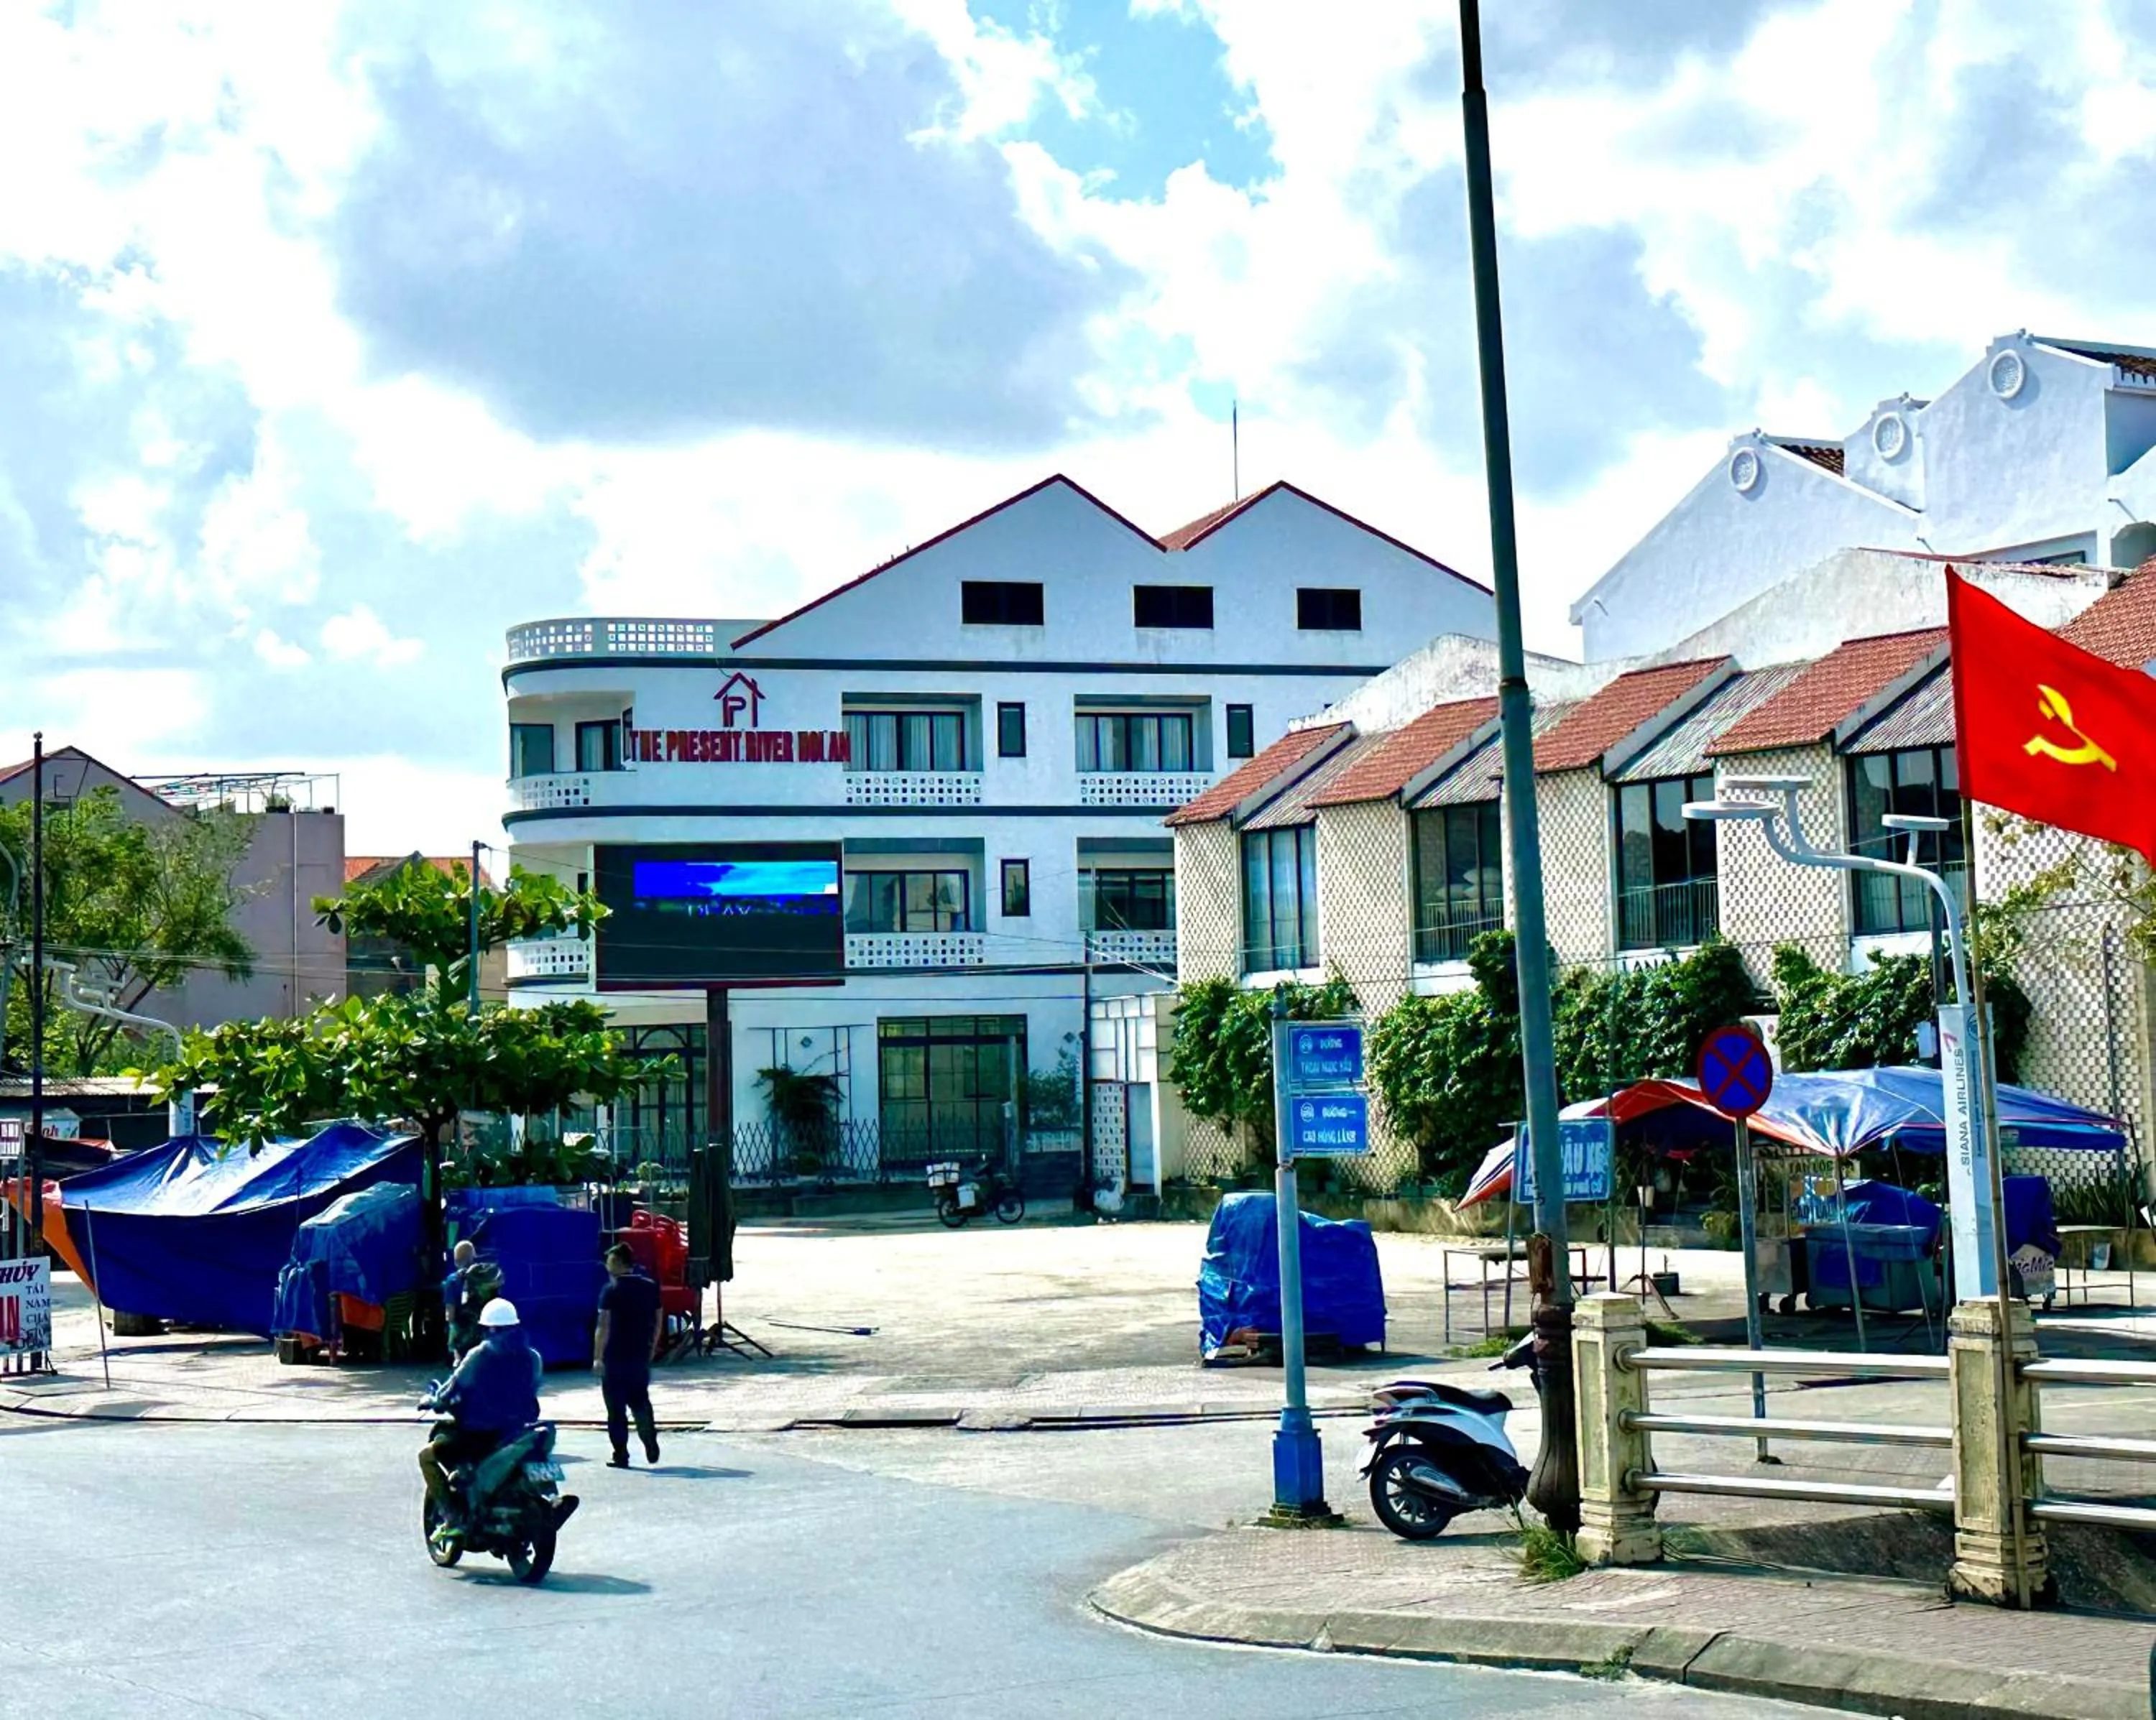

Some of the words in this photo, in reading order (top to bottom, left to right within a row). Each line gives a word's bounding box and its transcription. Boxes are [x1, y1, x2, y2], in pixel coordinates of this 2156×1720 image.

[630, 730, 665, 762] THE
[666, 730, 742, 762] PRESENT
[745, 731, 793, 762] RIVER
[828, 731, 851, 762] AN
[1953, 1048, 1968, 1116] AIRLINES
[1959, 1120, 1971, 1176] SIANA
